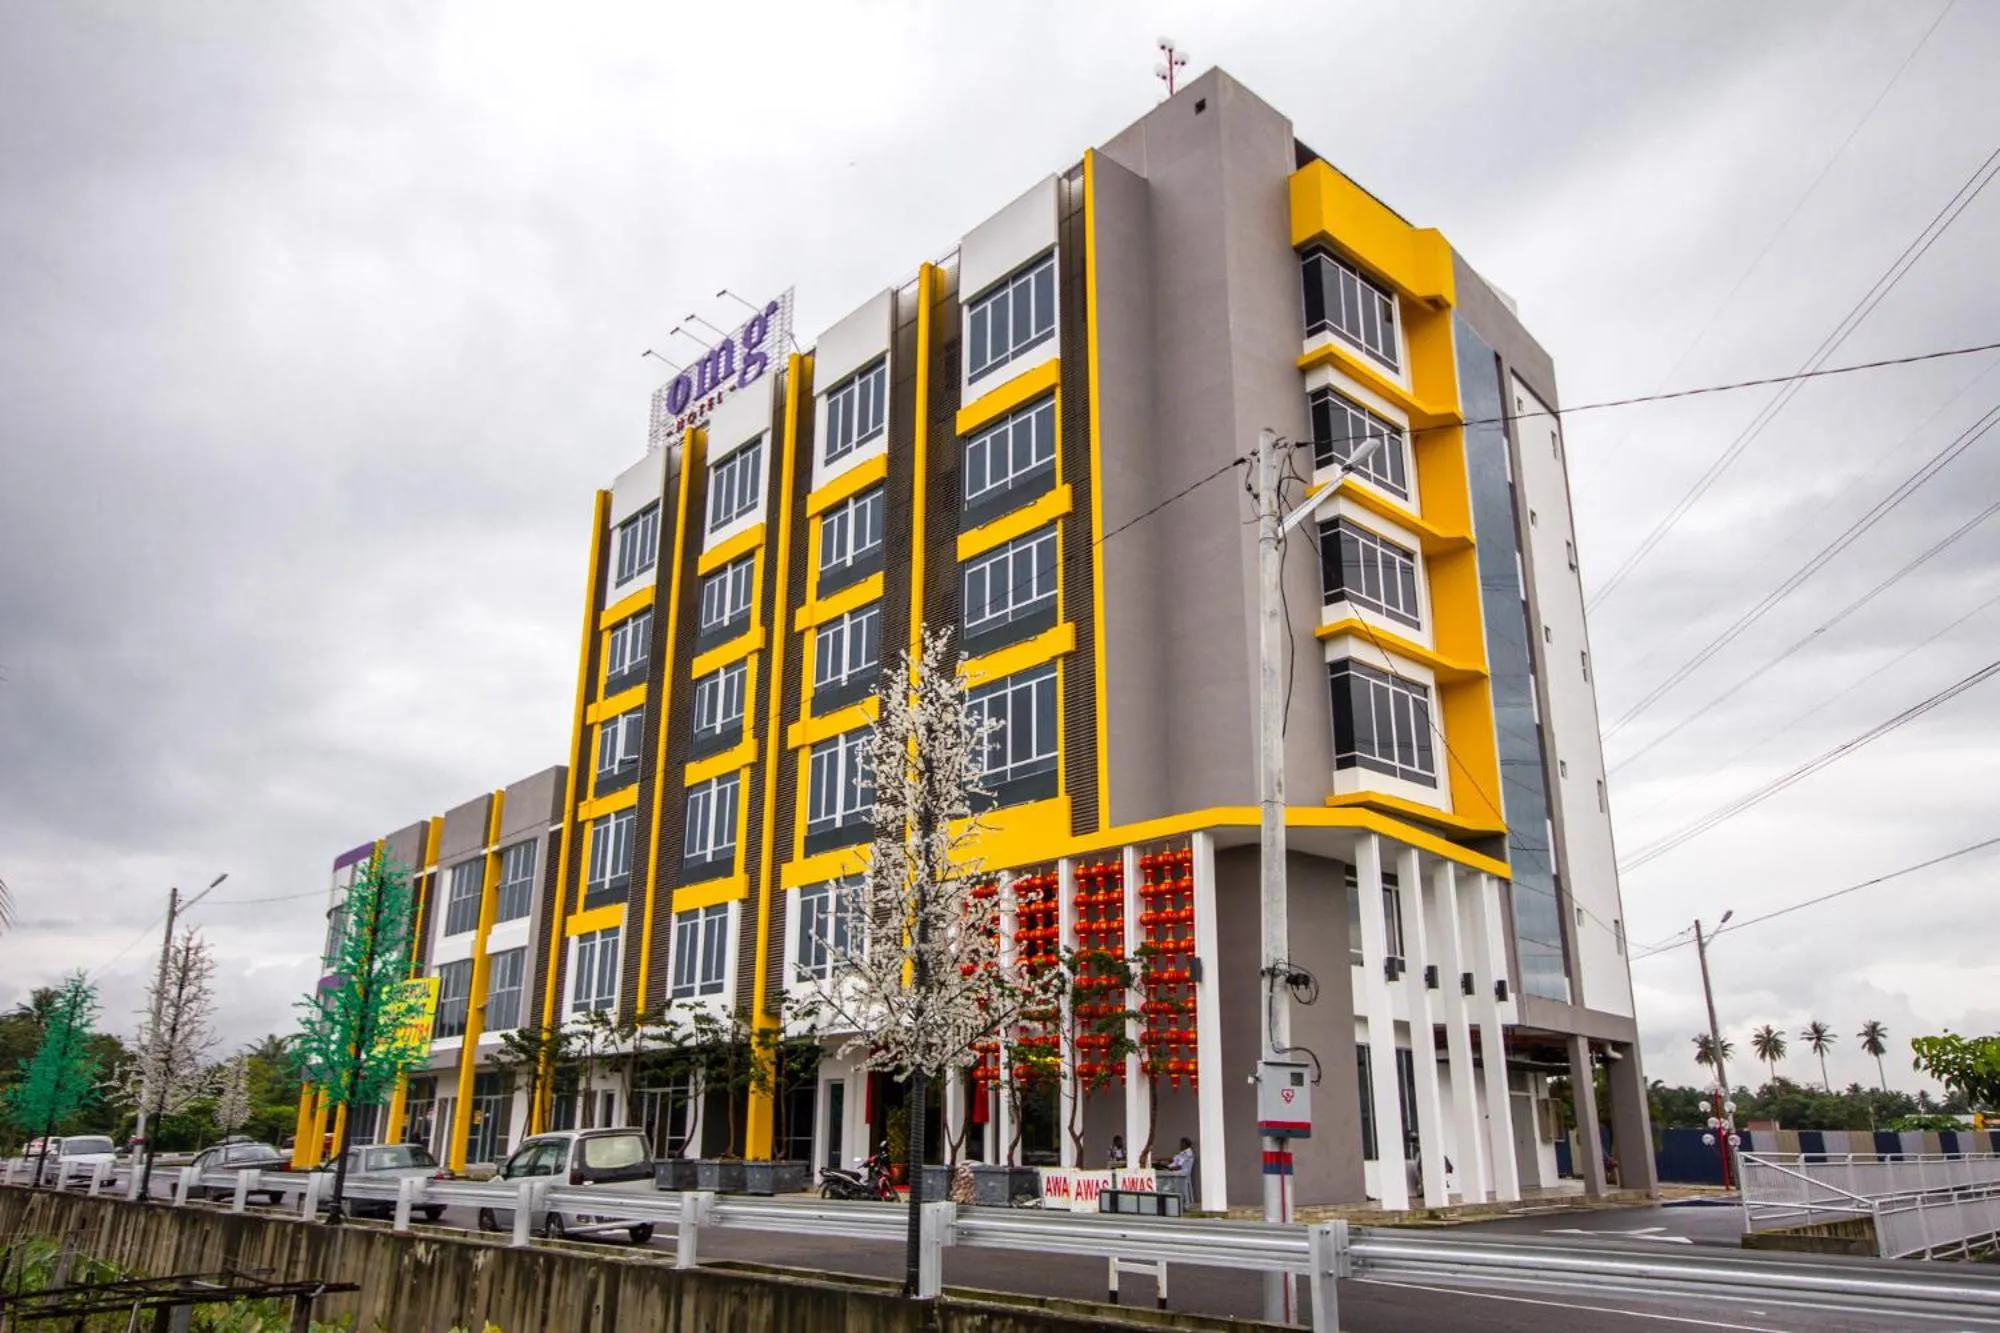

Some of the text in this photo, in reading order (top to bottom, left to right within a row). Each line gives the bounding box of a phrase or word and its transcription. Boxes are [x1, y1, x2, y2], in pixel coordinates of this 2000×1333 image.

[667, 301, 778, 416] omg
[1045, 1176, 1071, 1198] AWA
[1121, 1177, 1153, 1192] AWAS
